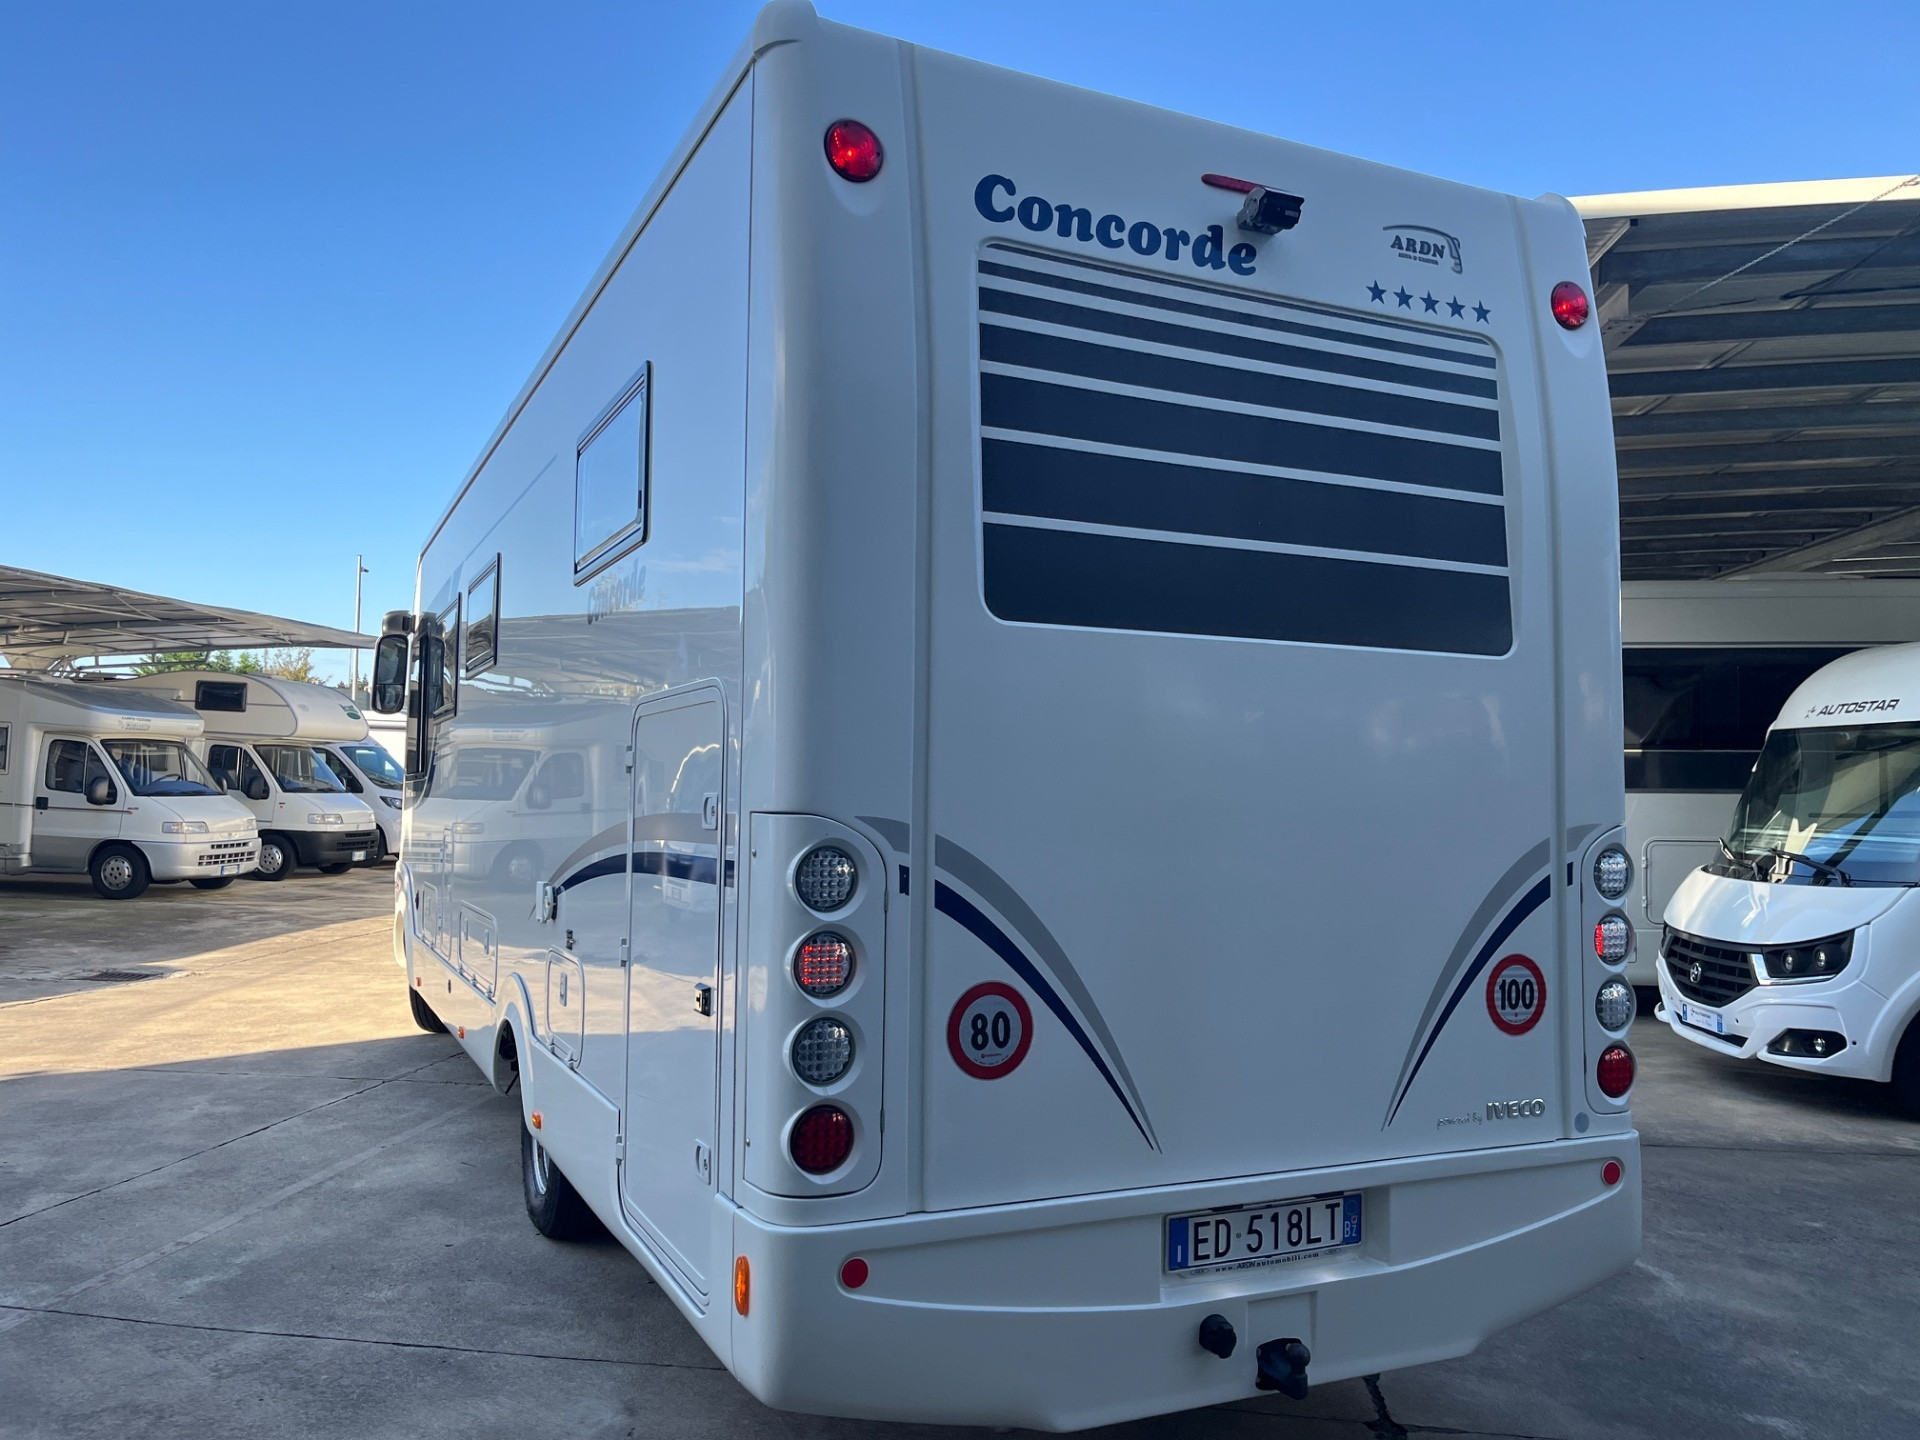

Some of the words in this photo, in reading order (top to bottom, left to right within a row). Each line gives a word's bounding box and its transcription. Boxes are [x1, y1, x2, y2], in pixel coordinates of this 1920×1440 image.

[975, 174, 1257, 276] Concorde
[1390, 235, 1445, 259] ARDN
[1817, 699, 1900, 717] AUTOSTAR
[1499, 979, 1535, 1010] 100
[971, 1011, 1011, 1050] 80
[1486, 1099, 1546, 1121] IVECO
